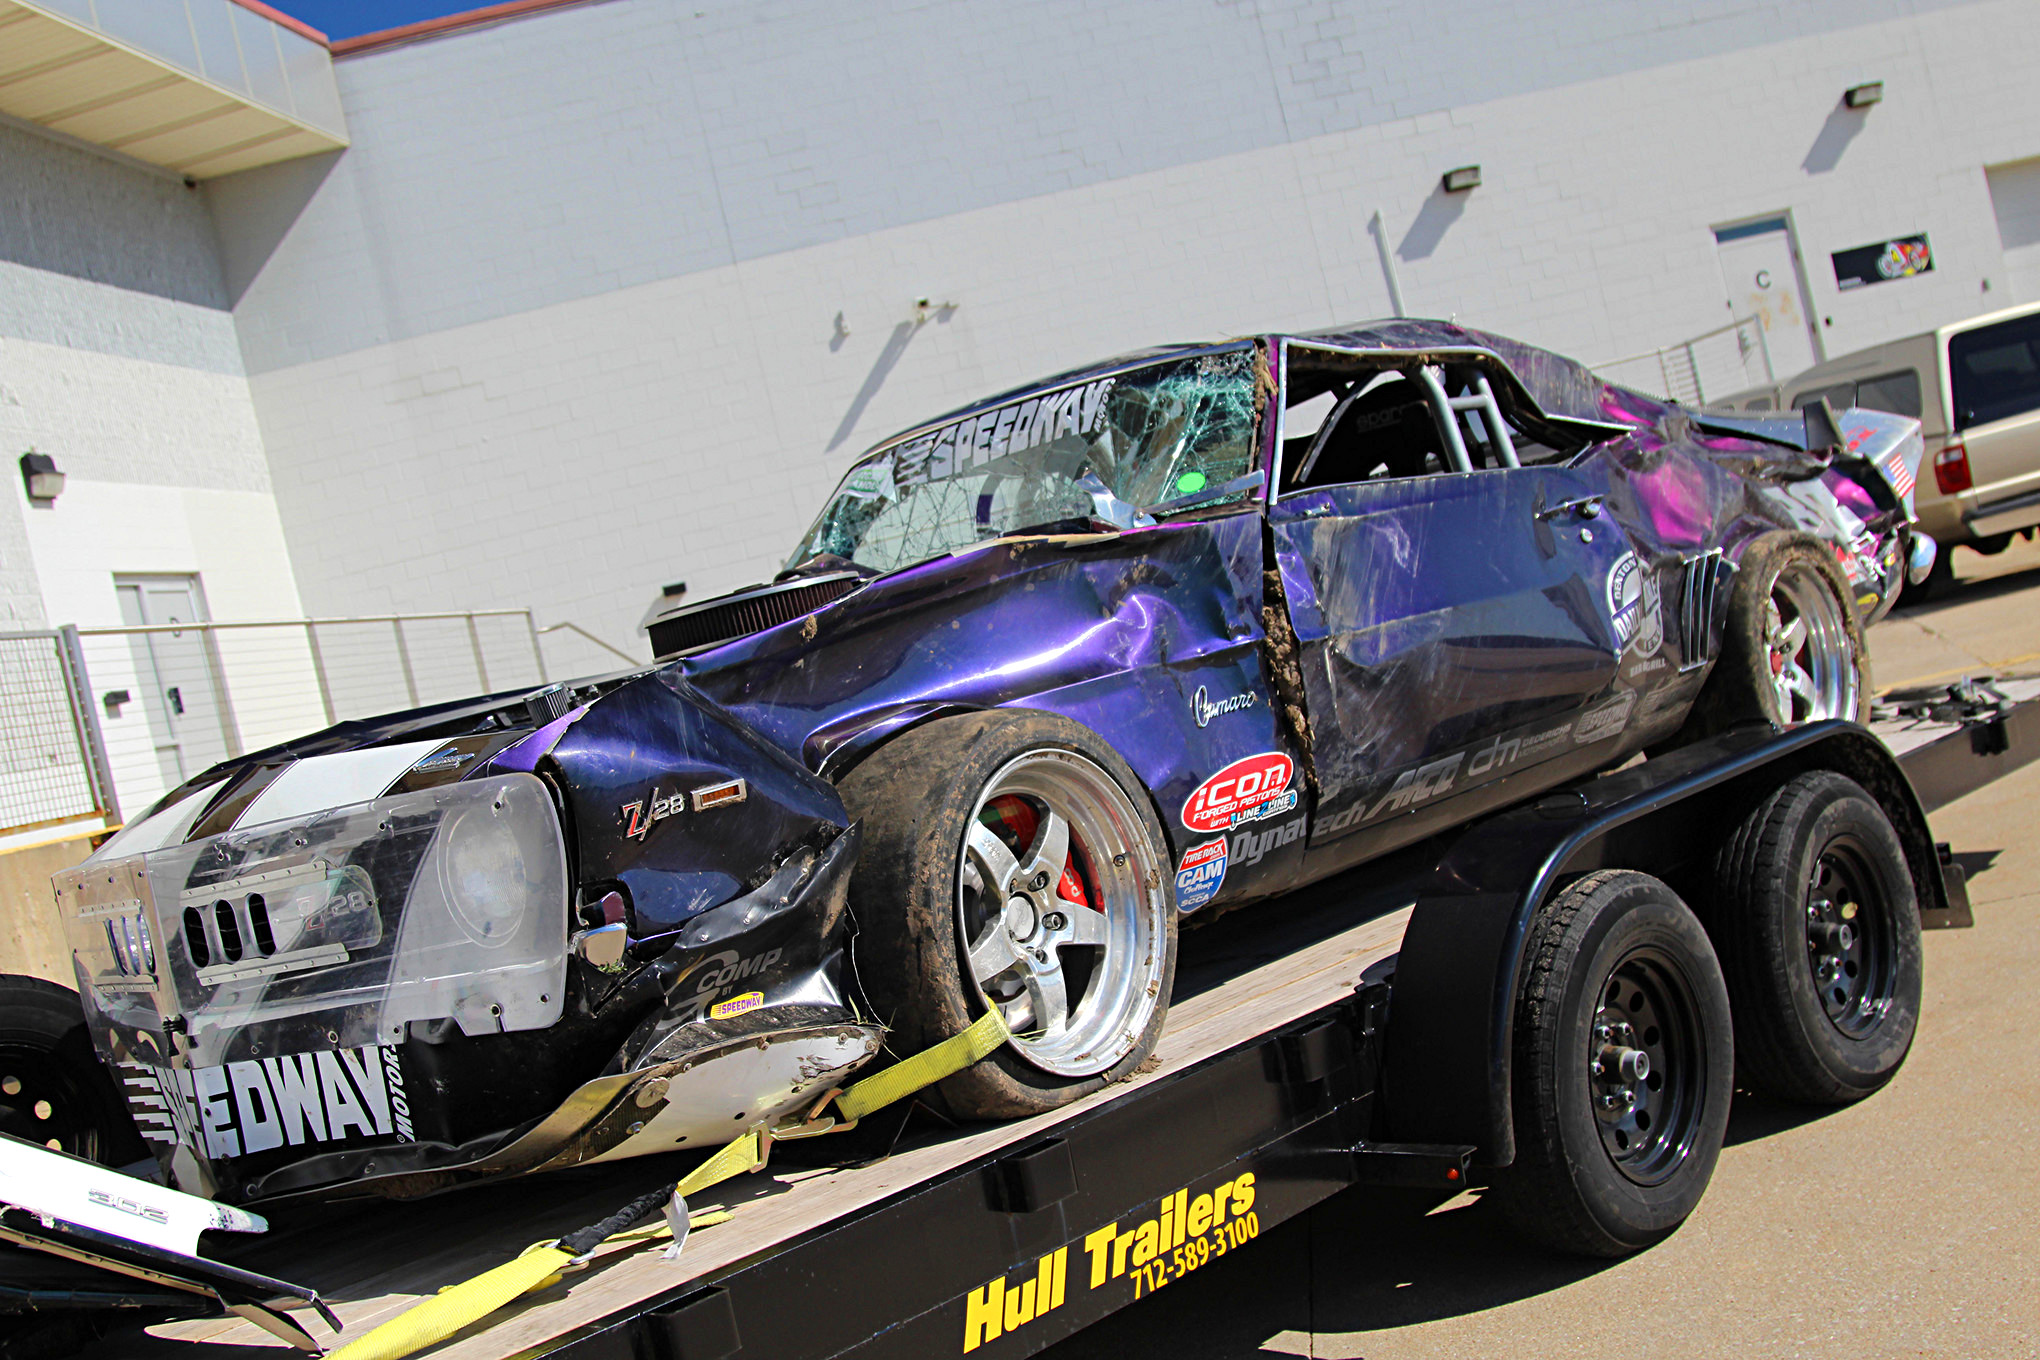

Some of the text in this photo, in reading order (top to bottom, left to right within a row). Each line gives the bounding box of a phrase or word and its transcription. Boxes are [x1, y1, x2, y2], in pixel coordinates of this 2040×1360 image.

[1756, 271, 1771, 288] C
[930, 378, 1114, 480] SPEEDWAY
[1613, 557, 1638, 601] DENTON
[1193, 685, 1257, 728] Camaro
[622, 786, 685, 842] Z/28
[1192, 787, 1281, 823] FORGED PISTONS
[1210, 816, 1229, 828] WITH
[1185, 842, 1225, 865] TIRE RACK
[1178, 859, 1224, 889] CAM
[1180, 893, 1210, 907] SCCA
[697, 947, 783, 993] COMP
[721, 985, 734, 997] BY
[721, 995, 762, 1015] SPEEDWAY
[88, 1188, 169, 1225] 302
[963, 1172, 1256, 1354] Hull Trailers
[1130, 1212, 1259, 1300] 712-589-3100
